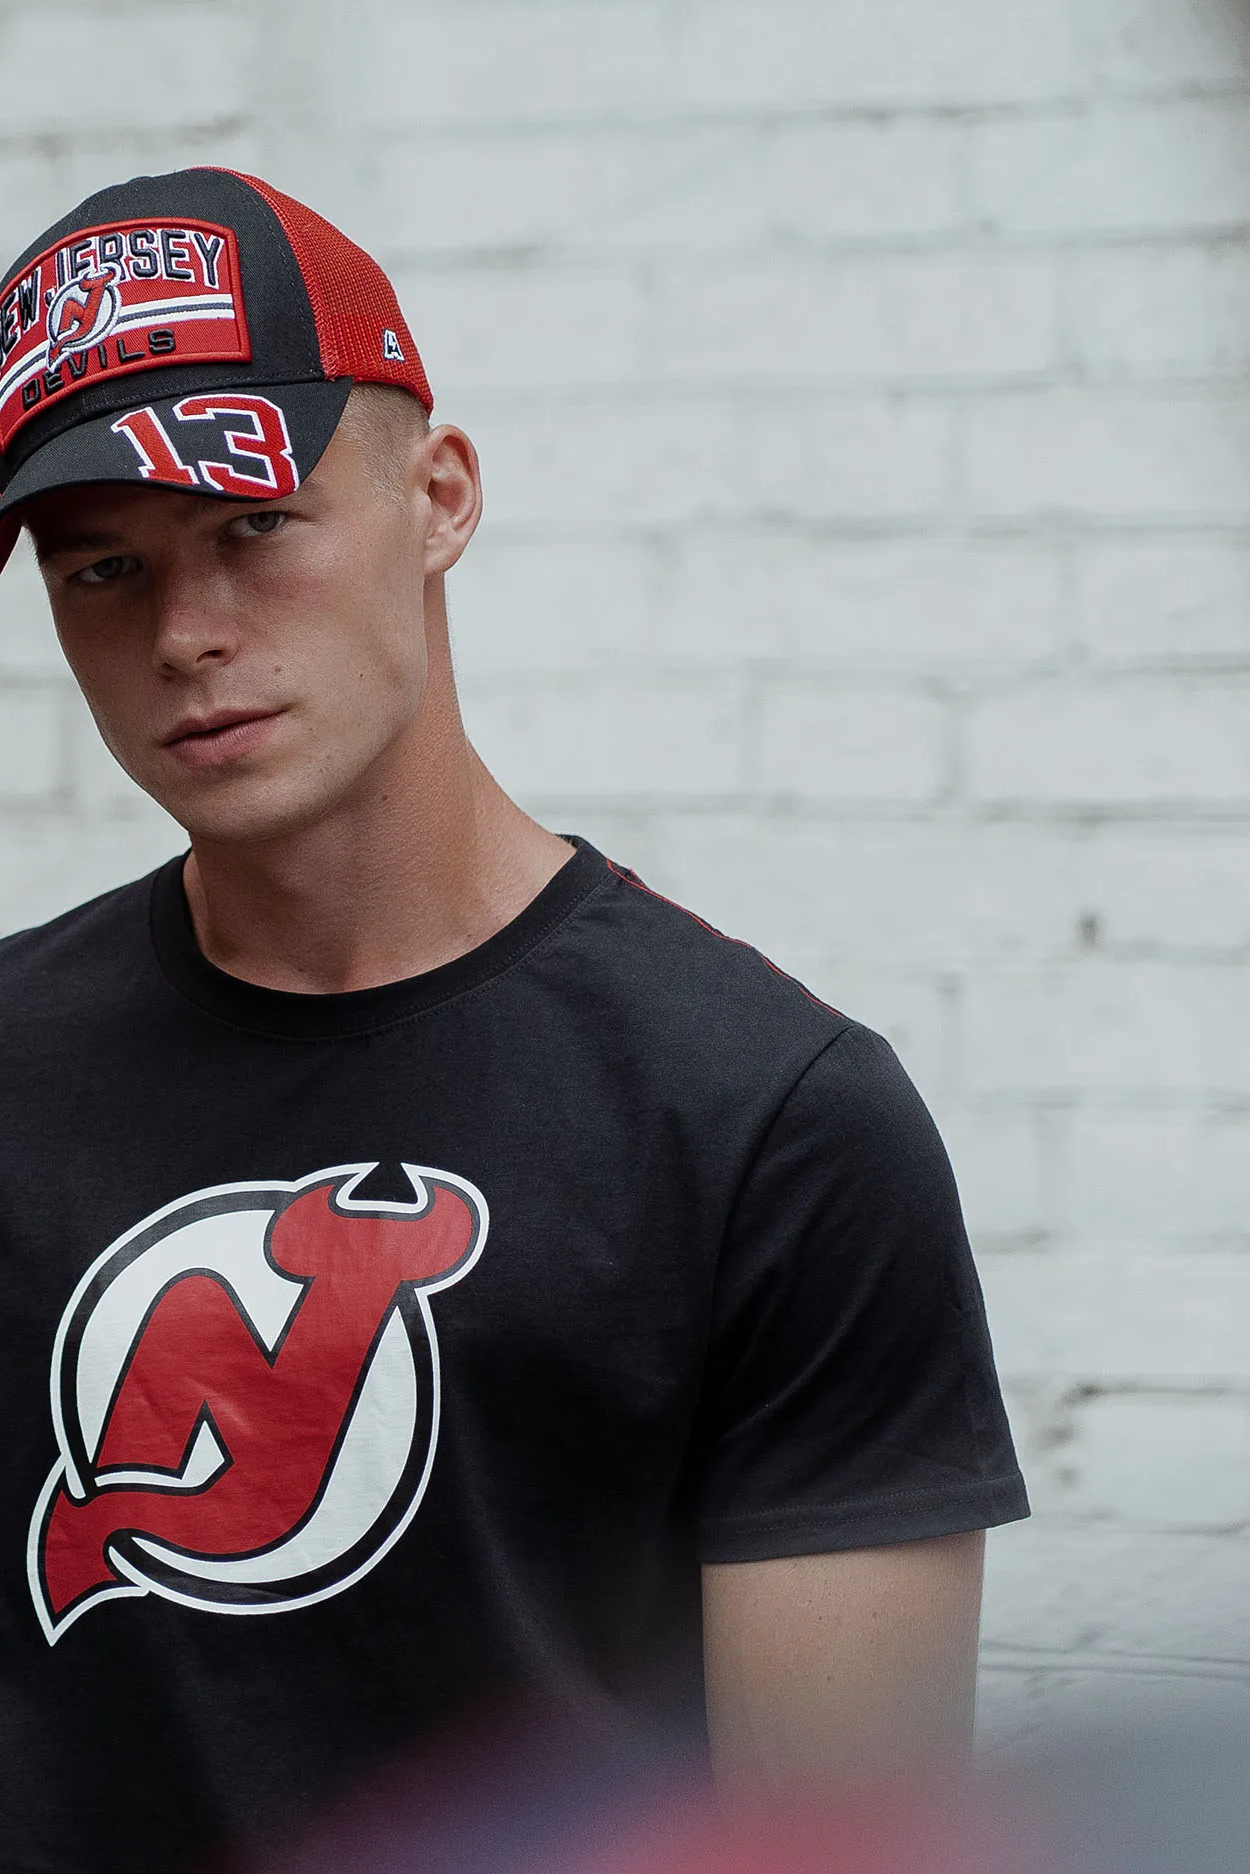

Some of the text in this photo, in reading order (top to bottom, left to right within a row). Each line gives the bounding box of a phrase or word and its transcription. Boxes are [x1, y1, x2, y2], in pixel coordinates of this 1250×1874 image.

[44, 228, 225, 306] JERSEY
[21, 328, 176, 410] DEVILS
[110, 393, 300, 499] 13
